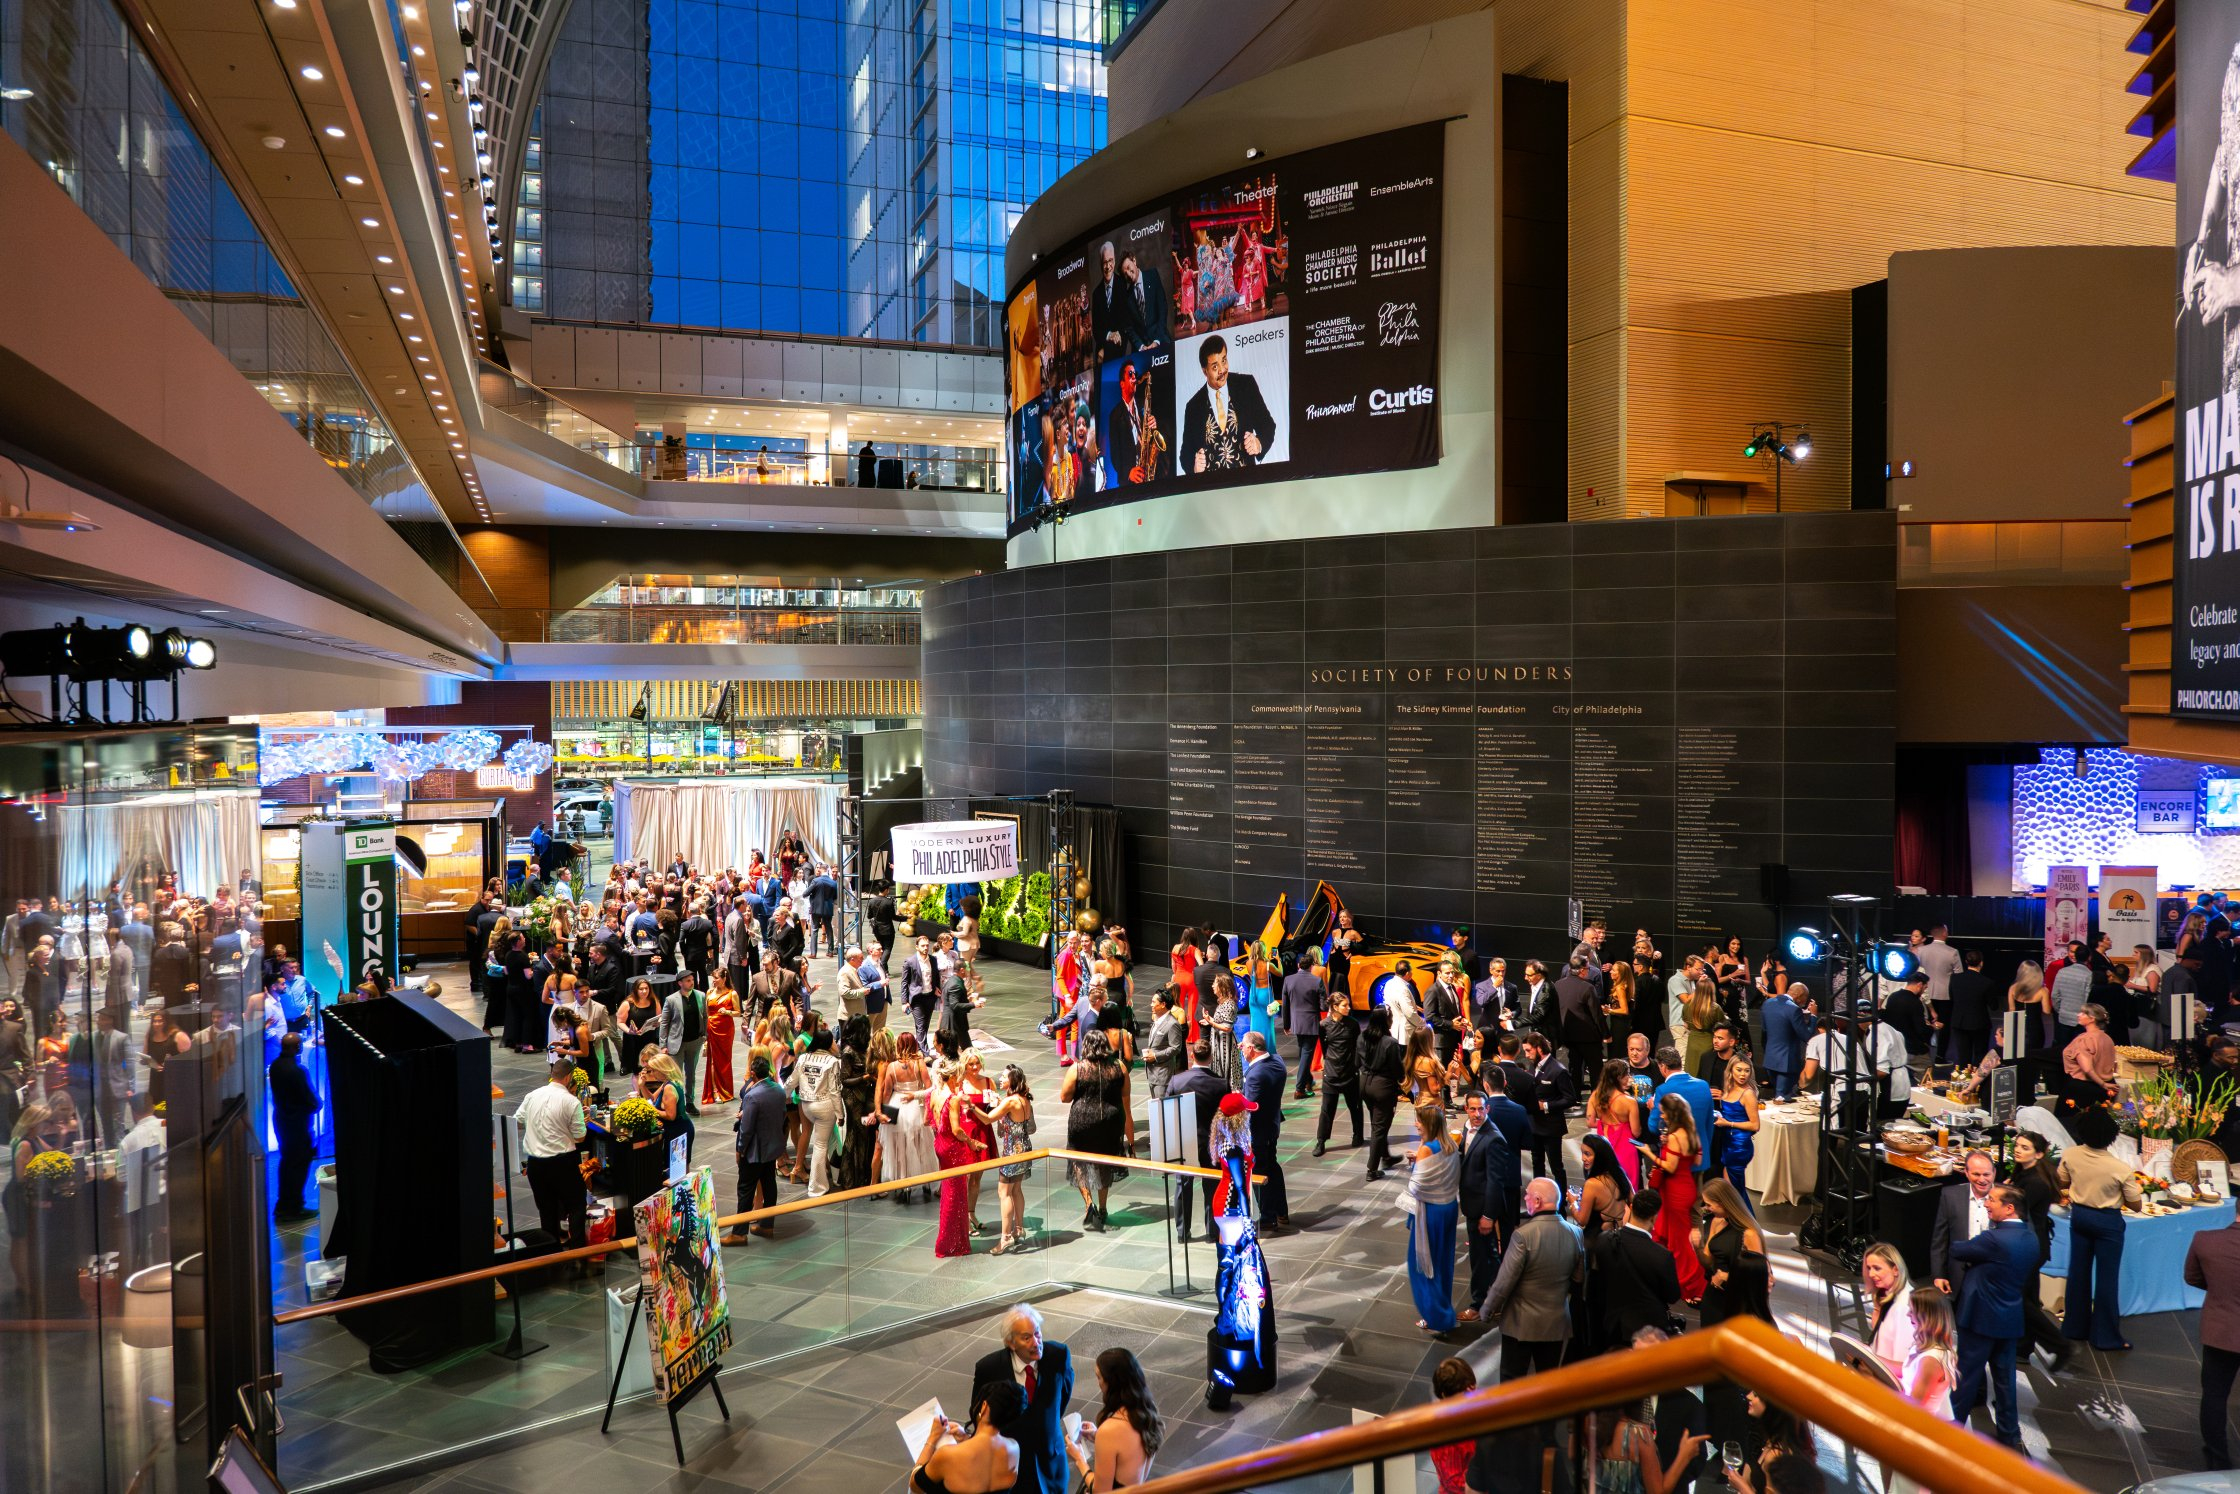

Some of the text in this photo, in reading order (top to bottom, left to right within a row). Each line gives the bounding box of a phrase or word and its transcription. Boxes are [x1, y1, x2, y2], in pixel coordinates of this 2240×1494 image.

[1234, 184, 1279, 206] Theater
[1304, 181, 1359, 202] PHILADELPHIA
[1370, 176, 1434, 197] EnsembleArts
[1309, 190, 1354, 207] ORCHESTRA
[1130, 219, 1165, 242] Comedy
[1371, 235, 1427, 251] PHILADELPHIA
[1305, 244, 1358, 263] PHILADELPHIA
[1305, 254, 1358, 271] CHAMBER MUSIC
[1371, 245, 1428, 272] Ballet
[1058, 256, 1085, 280] Broadway
[1305, 263, 1358, 284] SOCIETY
[1333, 279, 1357, 288] beautiful
[1378, 302, 1418, 319] Opera
[1305, 316, 1351, 331] THE CHAMBER
[1315, 324, 1357, 338] ORCHESTRA
[1234, 327, 1285, 347] Speakers
[1305, 333, 1355, 348] PHILADELPHIA
[1151, 354, 1169, 368] Jazz
[1060, 380, 1090, 401] Community
[1369, 384, 1434, 411] Curtis
[1028, 404, 1040, 417] Family
[2189, 479, 2215, 560] IS
[2190, 603, 2237, 628] Celebrate
[2190, 638, 2221, 669] legacy
[1311, 666, 1573, 683] SOCIETY OF FOUNDERS
[1251, 704, 1362, 714] Commonwealth of Pennsylvania
[2177, 689, 2240, 711] PHILORCH.OR
[1397, 705, 1526, 715] The Sidney Kimmel Foundation
[1552, 705, 1642, 715] City of Philadelphia
[480, 768, 533, 789] CURTAIN CALL
[2140, 801, 2193, 822] ENCORE BAR
[356, 836, 385, 846] TD Bank
[911, 832, 1012, 848] MODERN LUXURY
[2057, 874, 2077, 883] EMILY
[2059, 882, 2080, 892] PARIS
[360, 864, 384, 978] LOUNG
[2116, 909, 2138, 919] Oasis
[665, 1318, 733, 1401] Ferrari
